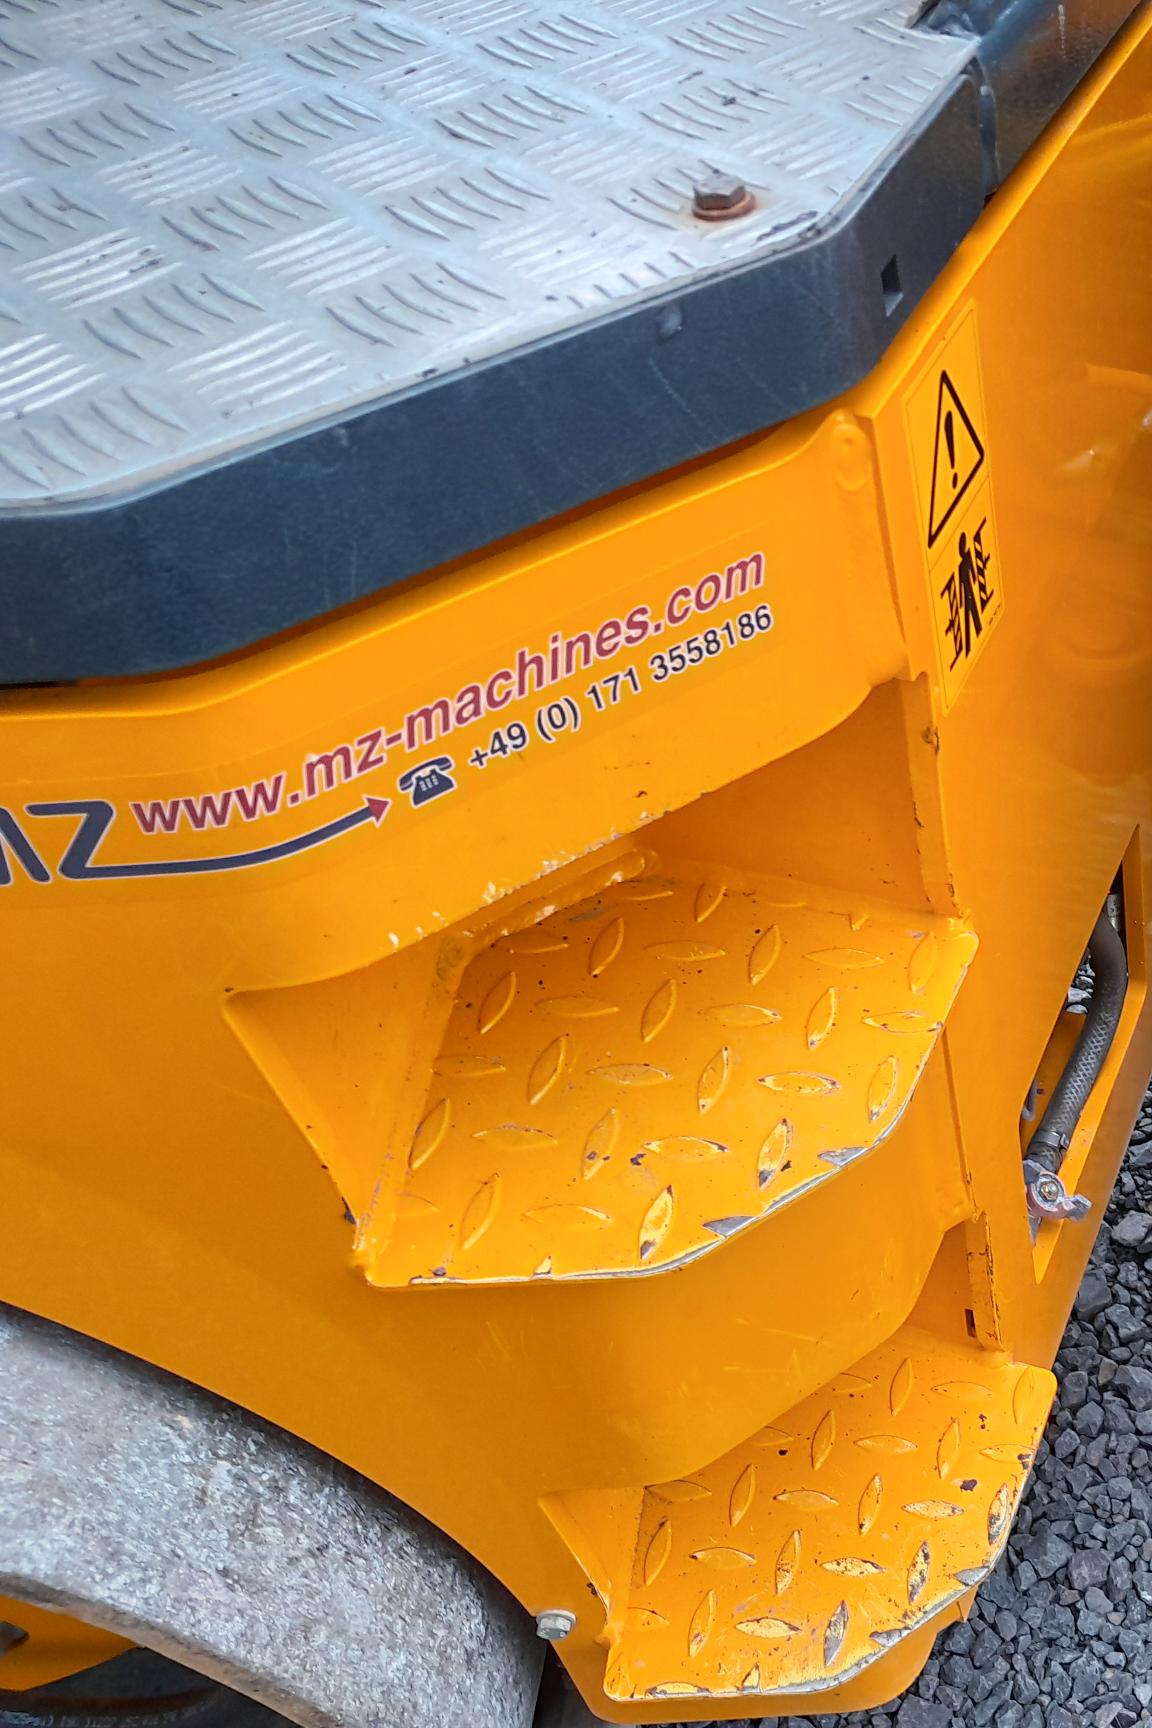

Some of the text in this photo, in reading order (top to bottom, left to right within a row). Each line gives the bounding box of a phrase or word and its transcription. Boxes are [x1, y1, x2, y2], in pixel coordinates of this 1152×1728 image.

[131, 550, 766, 834] www.mz-machines.com
[469, 603, 774, 769] +49 (0) 171 3558186
